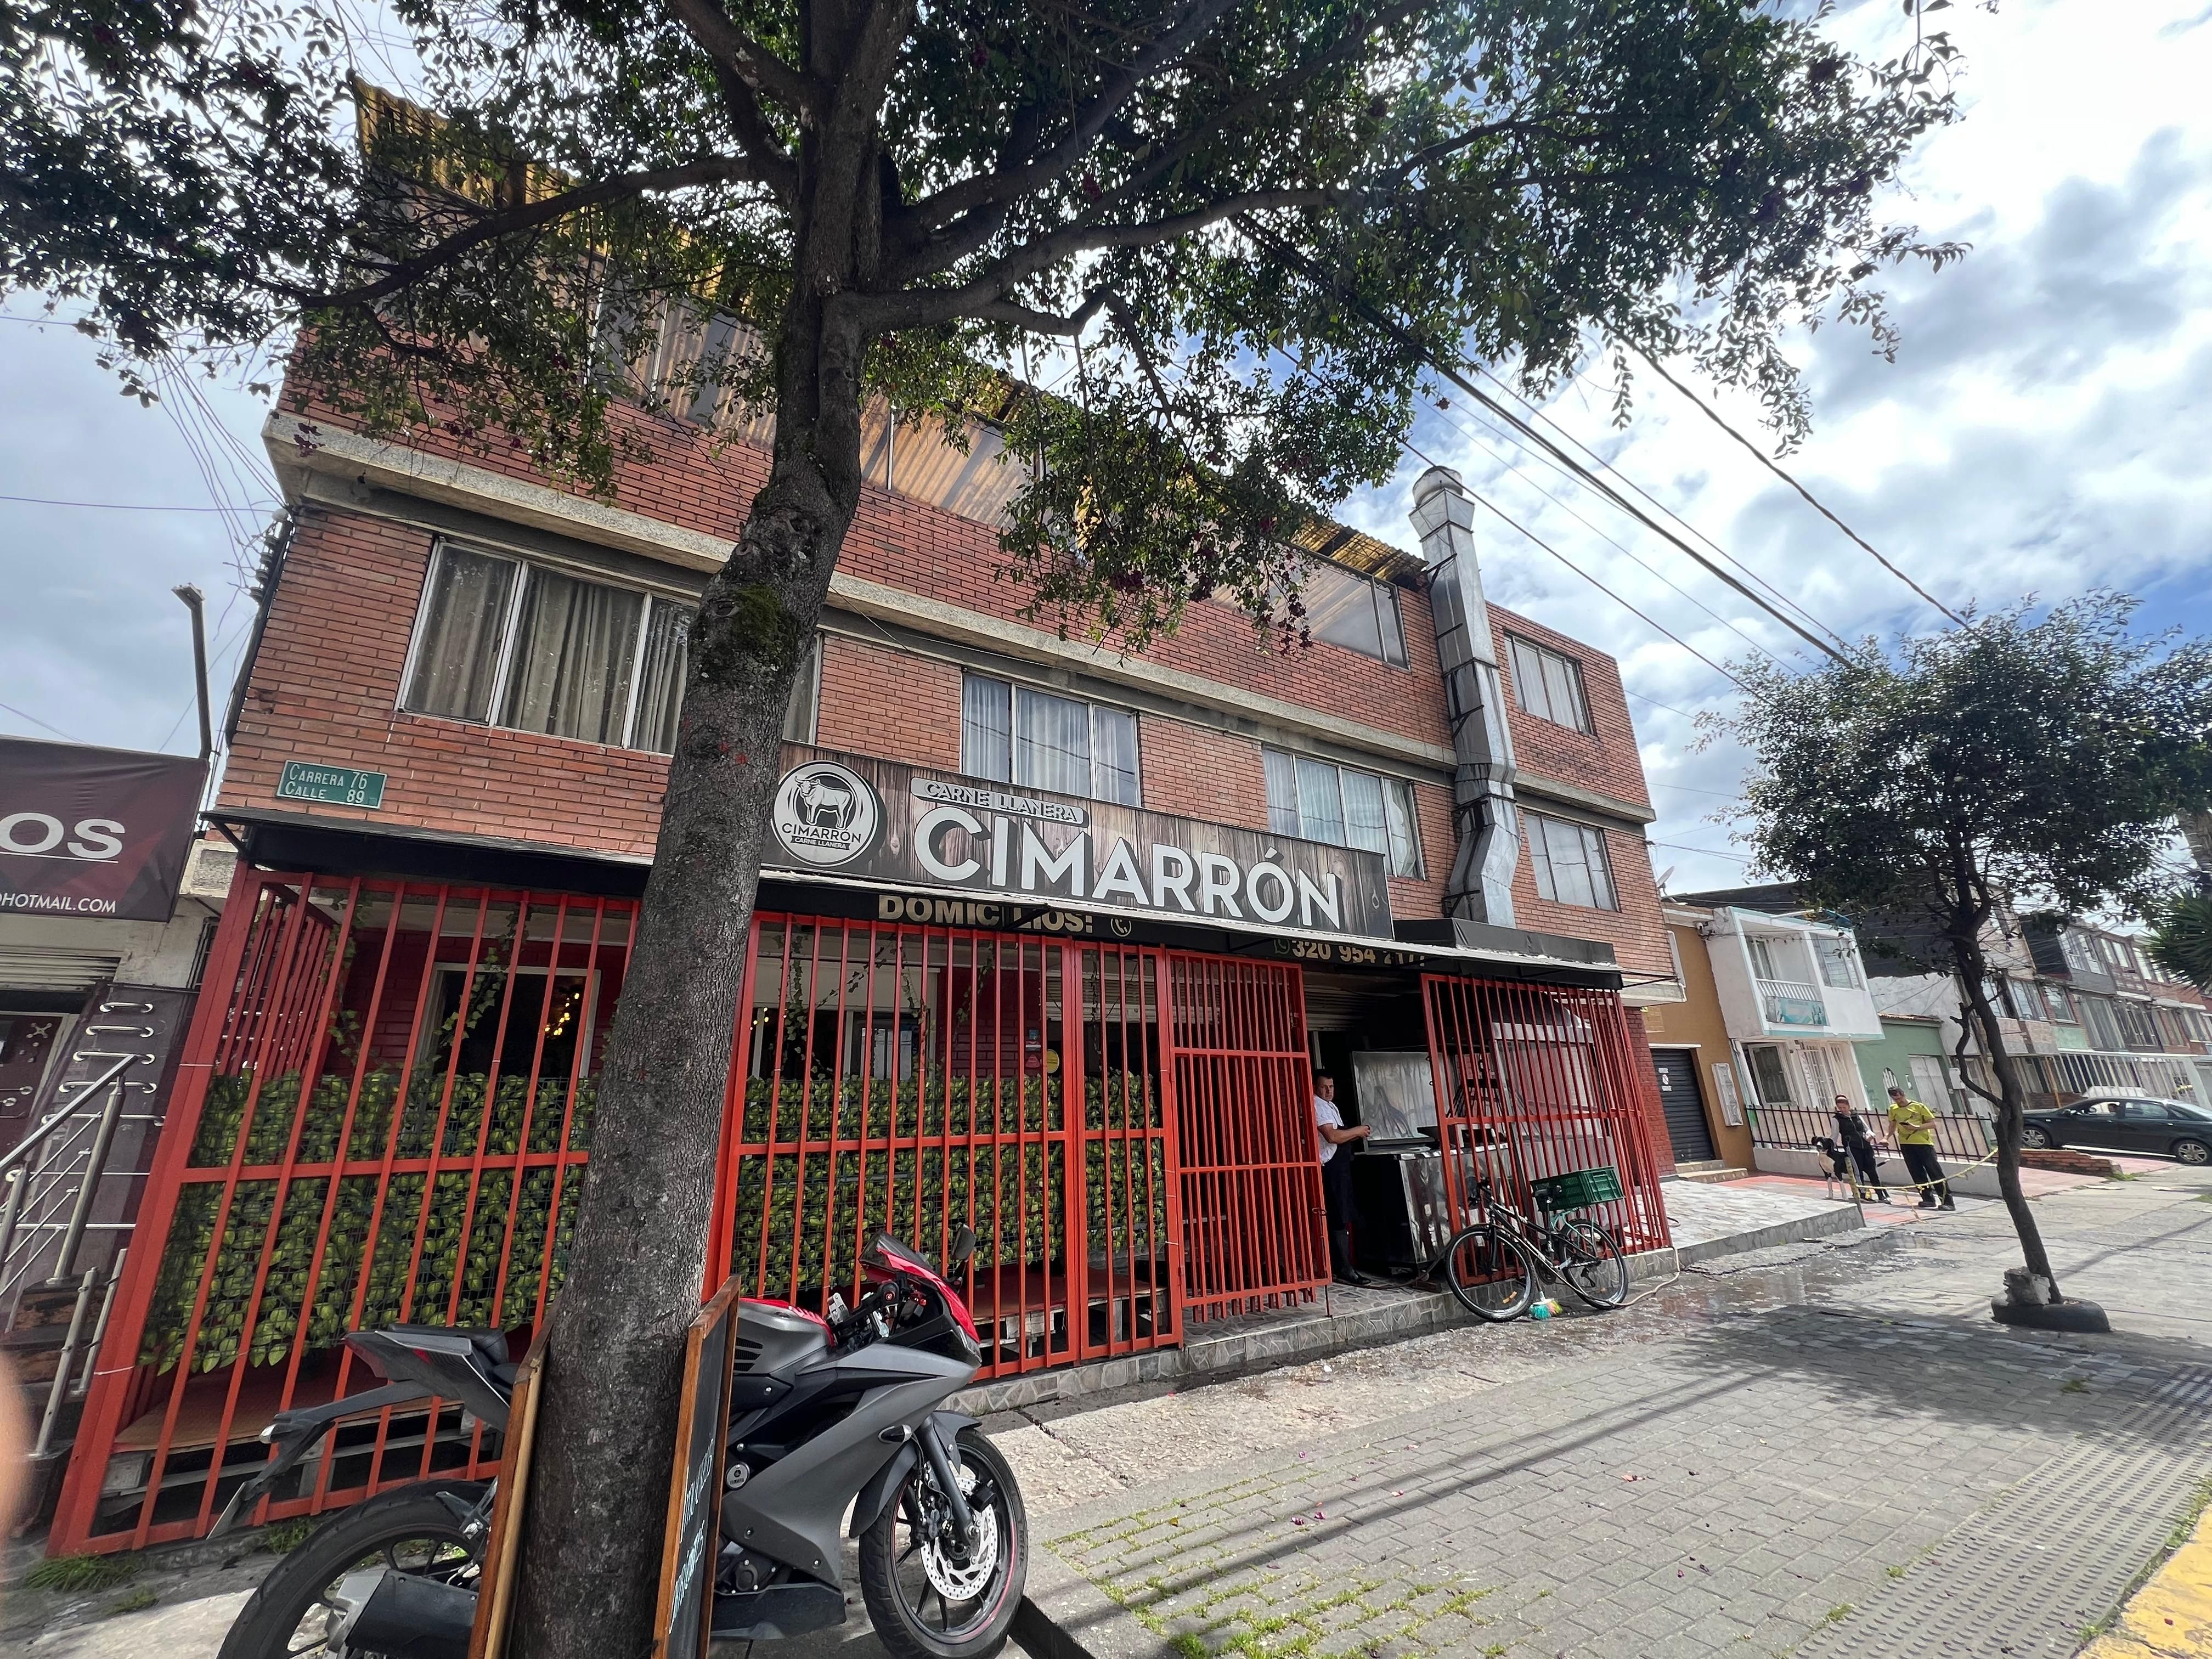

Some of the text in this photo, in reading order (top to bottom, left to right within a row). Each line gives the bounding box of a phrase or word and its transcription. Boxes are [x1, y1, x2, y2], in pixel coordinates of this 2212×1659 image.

[289, 764, 369, 789] CARRERA 76
[285, 781, 365, 804] CALLE 89
[924, 781, 1077, 822] CARNE LLANERA
[782, 823, 861, 843] CIMARRÓN
[794, 837, 847, 849] CARNE LLANERA
[914, 806, 1342, 930] CIMARRÓN
[0, 893, 116, 913] HOTMAIL.COM
[1292, 940, 1331, 960] 320
[1339, 945, 1376, 963] 954
